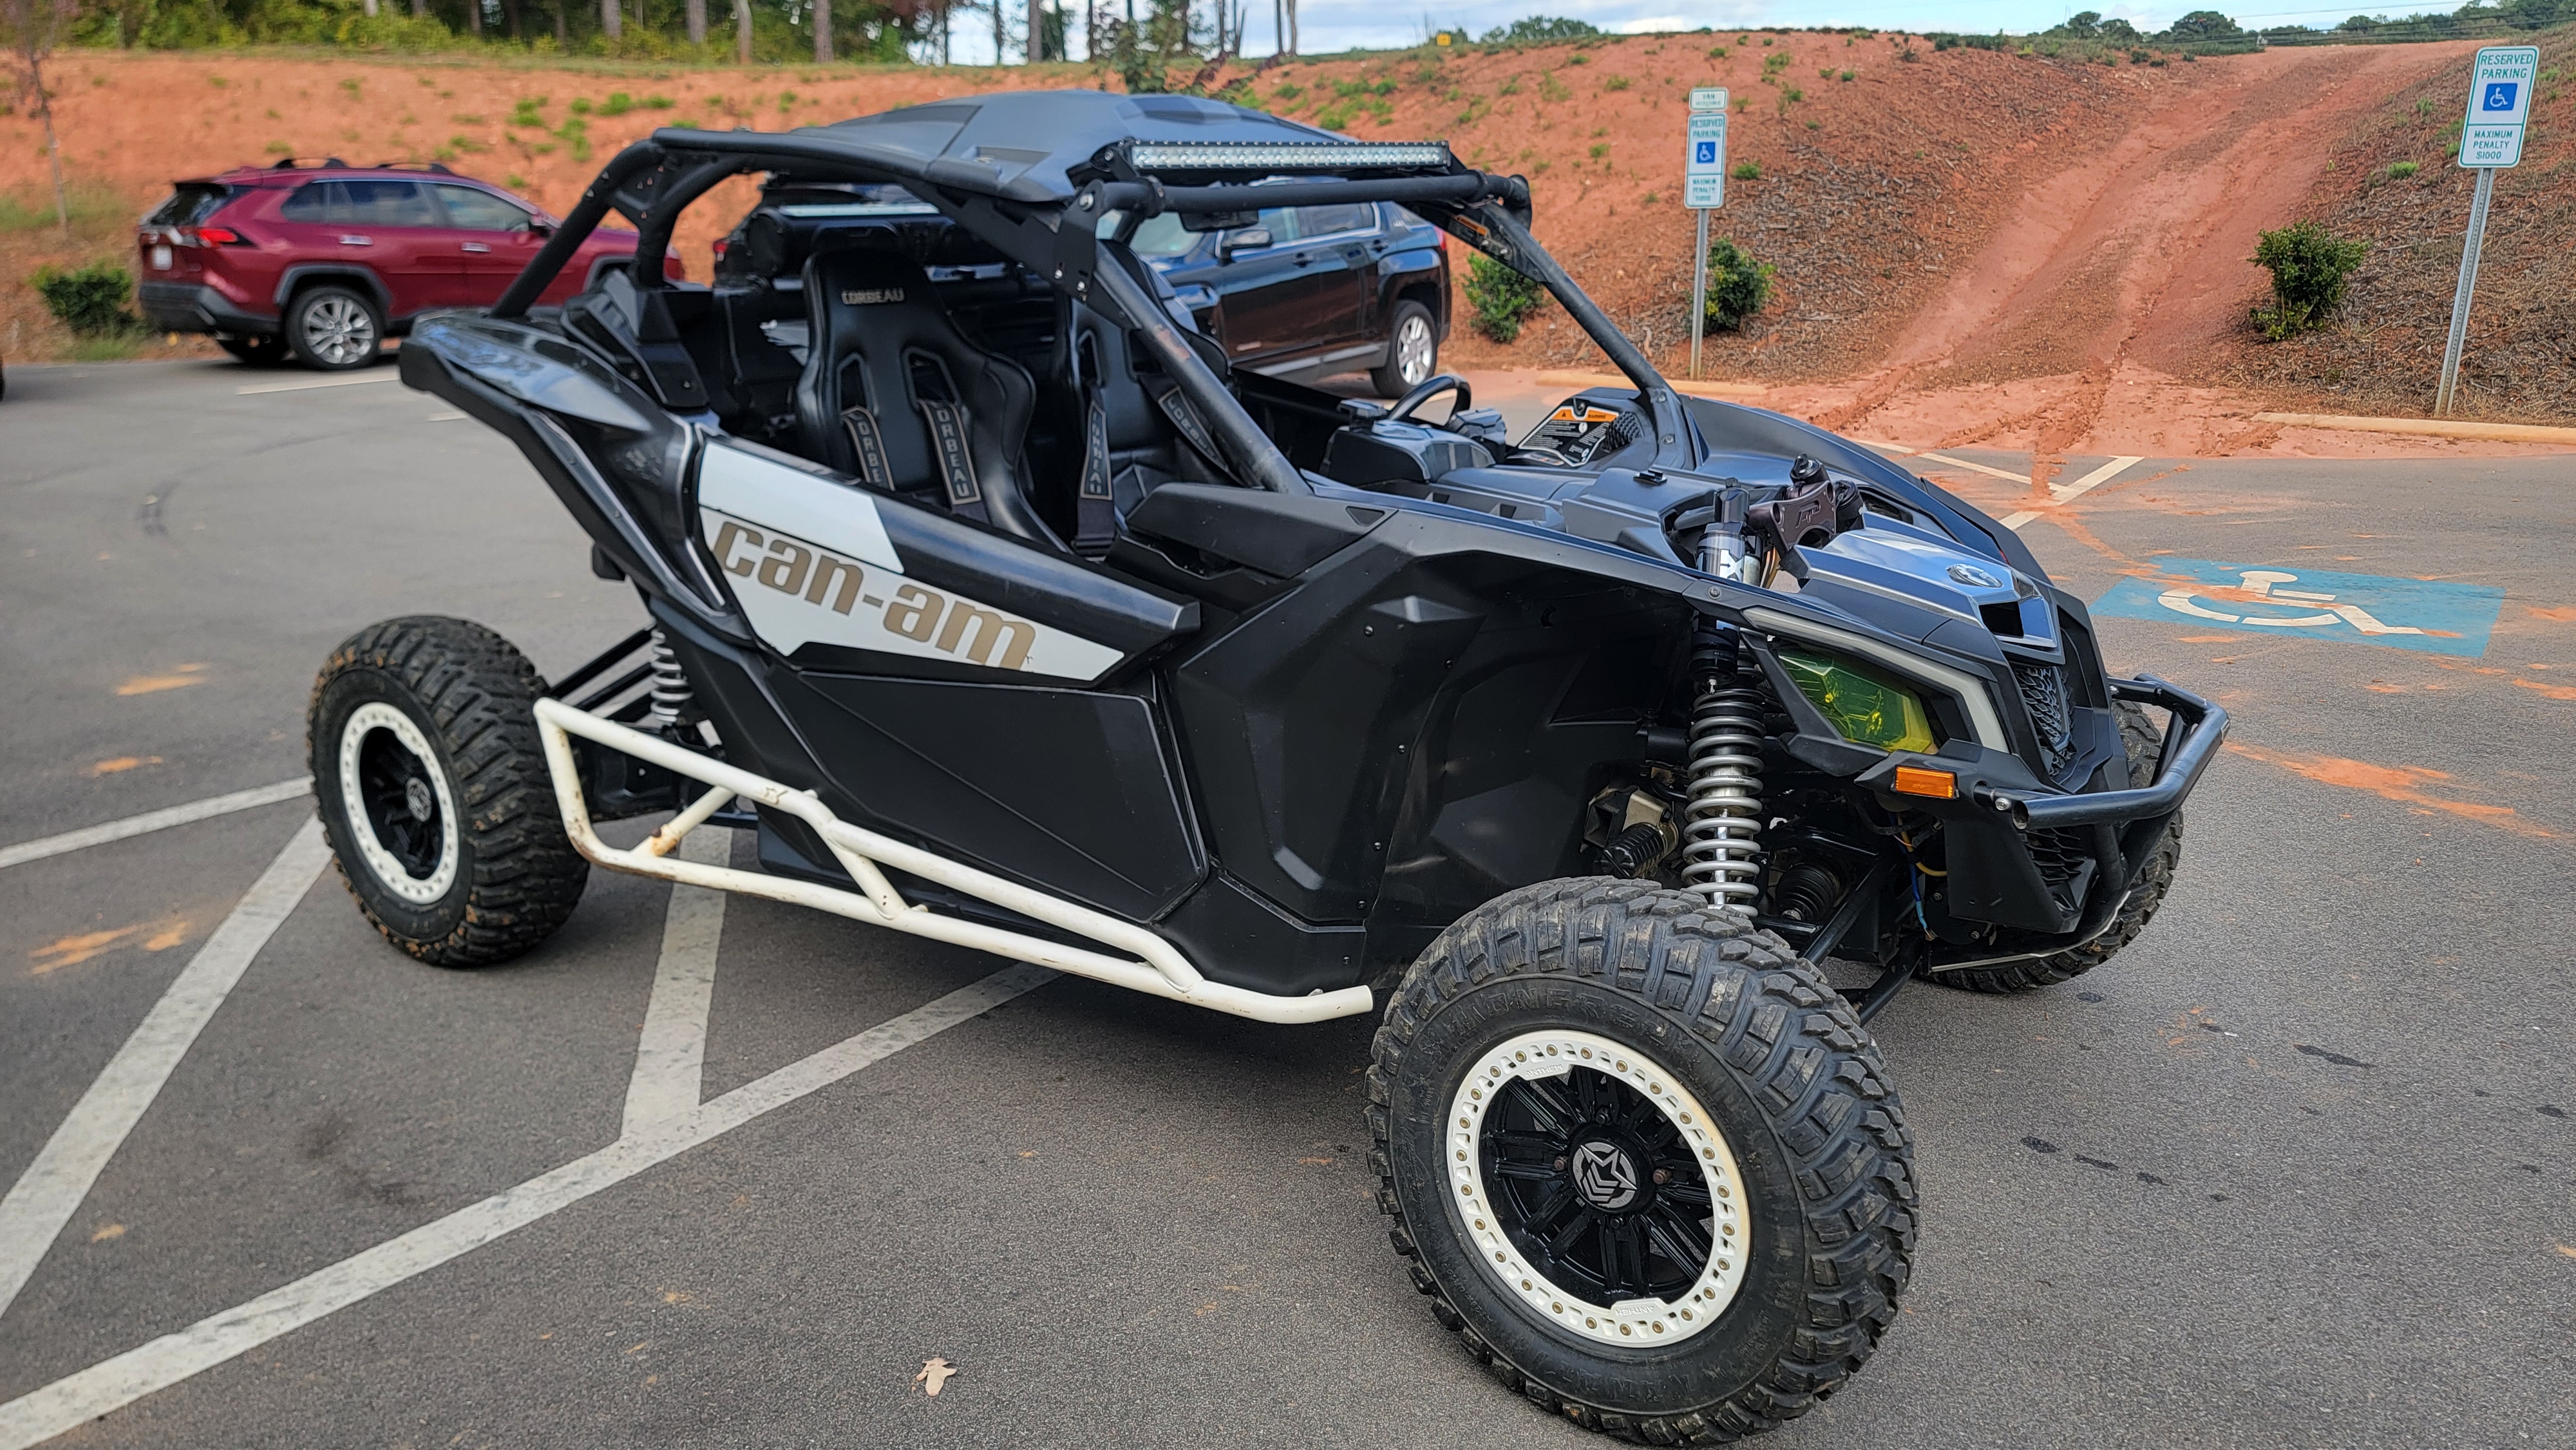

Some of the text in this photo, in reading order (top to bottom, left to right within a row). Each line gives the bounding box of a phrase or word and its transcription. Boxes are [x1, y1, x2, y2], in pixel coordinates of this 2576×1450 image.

[2481, 54, 2533, 65] RESERVED
[2481, 68, 2528, 79] PARKING
[1690, 118, 1723, 127] RESERVED
[1692, 129, 1720, 138] PARKING
[2474, 129, 2513, 138] MAXIMUM
[2473, 140, 2510, 149] PENALTY
[840, 288, 904, 305] CORBEAU
[932, 402, 970, 497] ORBEAU
[713, 522, 1036, 670] can-am
[1526, 1064, 1563, 1077] ANTHEM
[1615, 1306, 1654, 1316] ANTHEM
